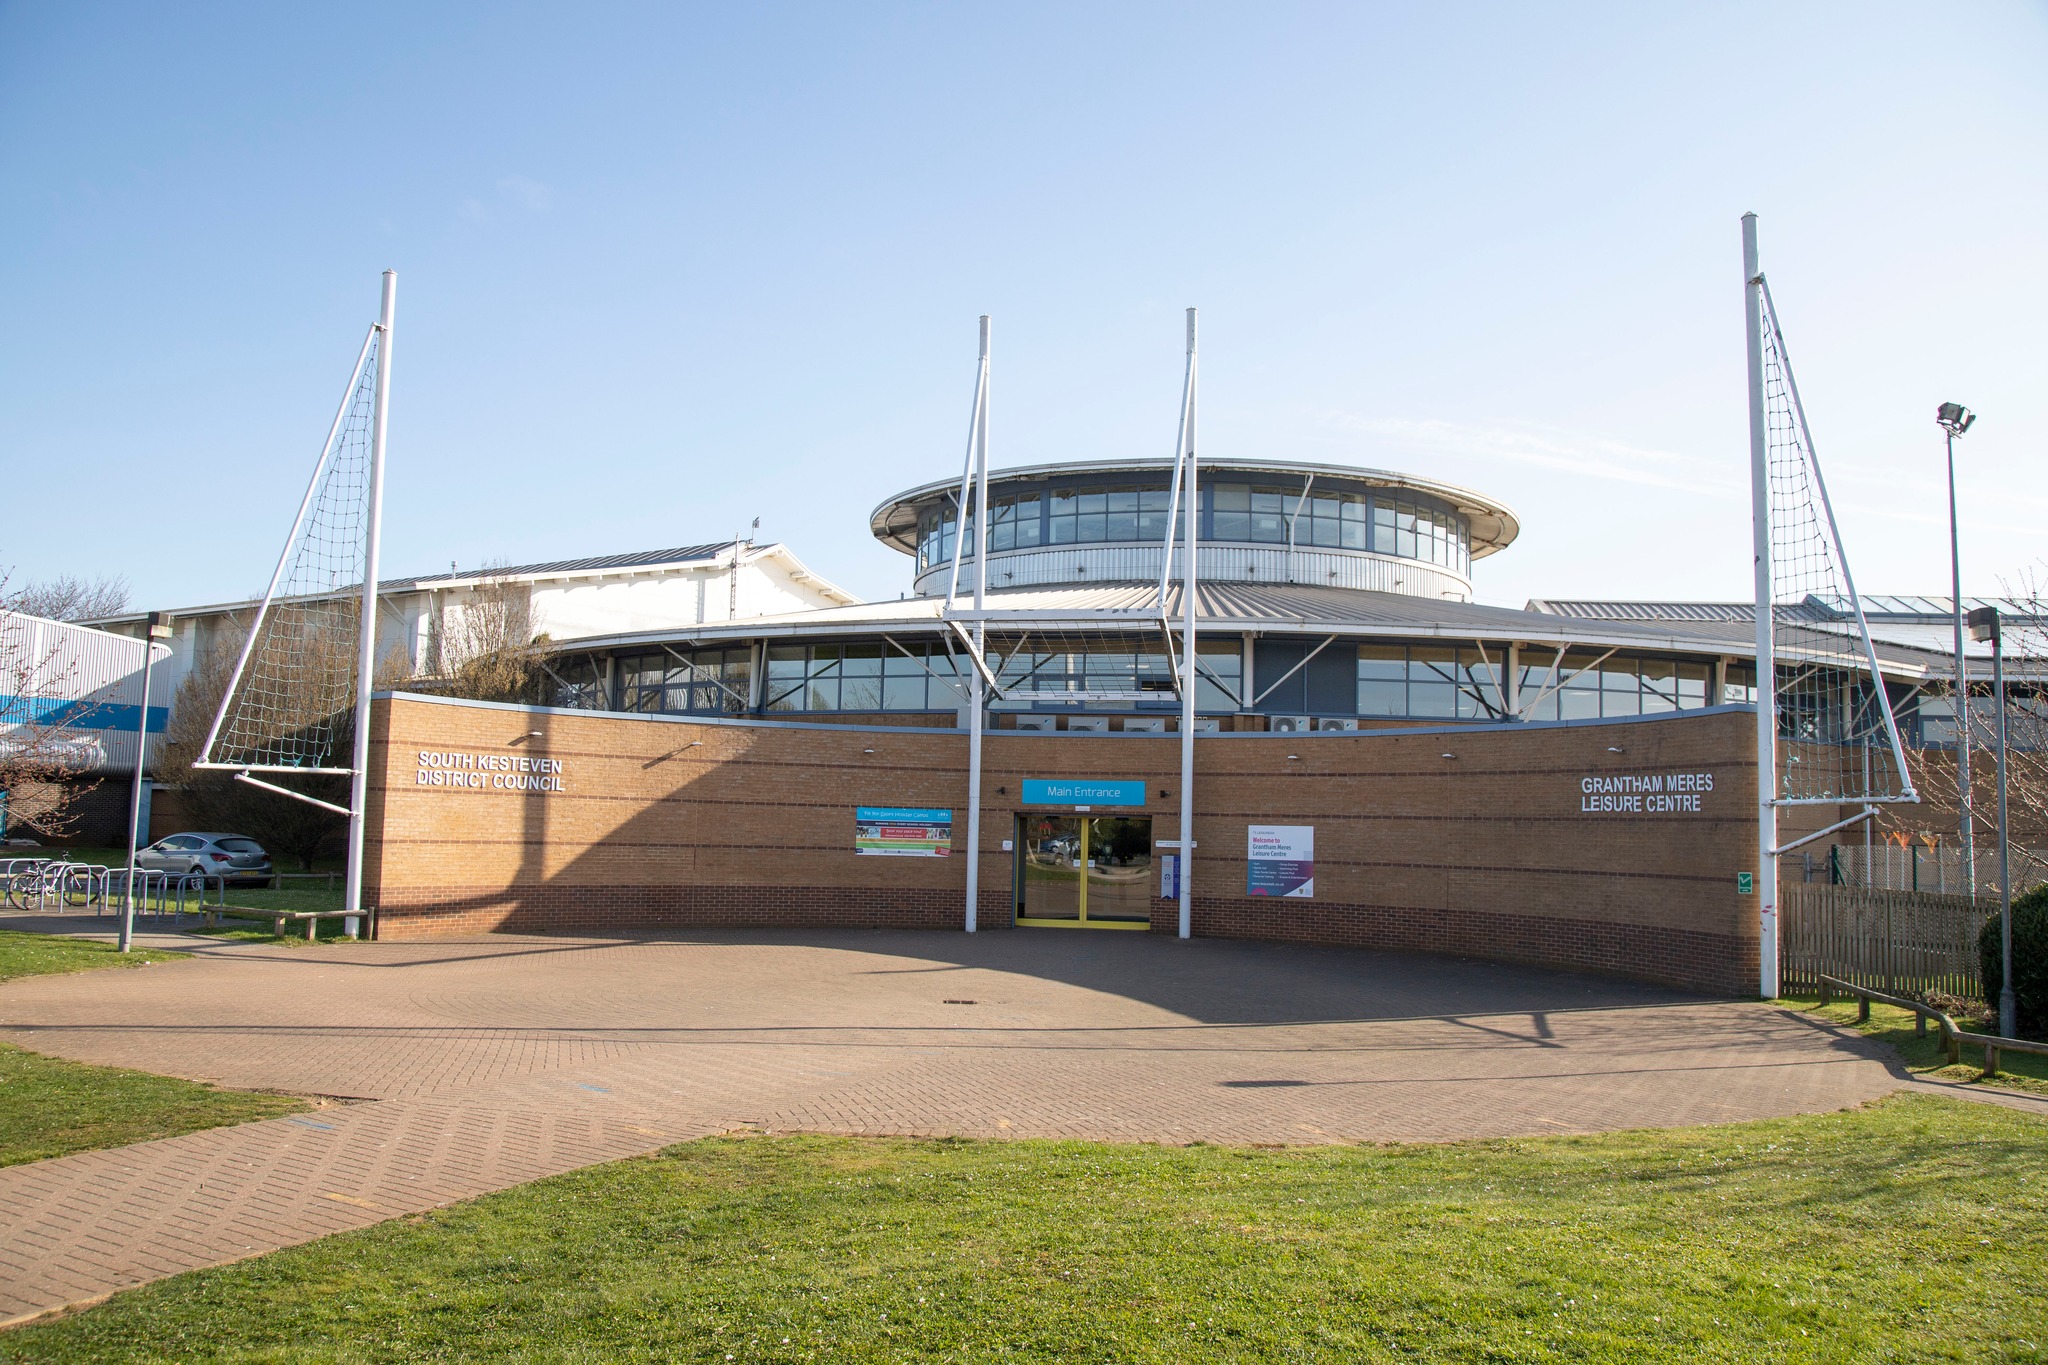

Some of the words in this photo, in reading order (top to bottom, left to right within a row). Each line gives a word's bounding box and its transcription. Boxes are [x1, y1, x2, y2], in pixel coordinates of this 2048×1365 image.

[418, 751, 473, 769] SOUTH
[477, 755, 562, 773] KESTEVEN
[416, 769, 489, 788] DISTRICT
[492, 774, 565, 791] COUNCIL
[1582, 776, 1663, 793] GRANTHAM
[1667, 773, 1714, 792] MERES
[1047, 786, 1072, 797] Main
[1075, 787, 1120, 798] Entrance
[1582, 796, 1642, 812] LEISURE
[1646, 795, 1701, 812] CENTRE
